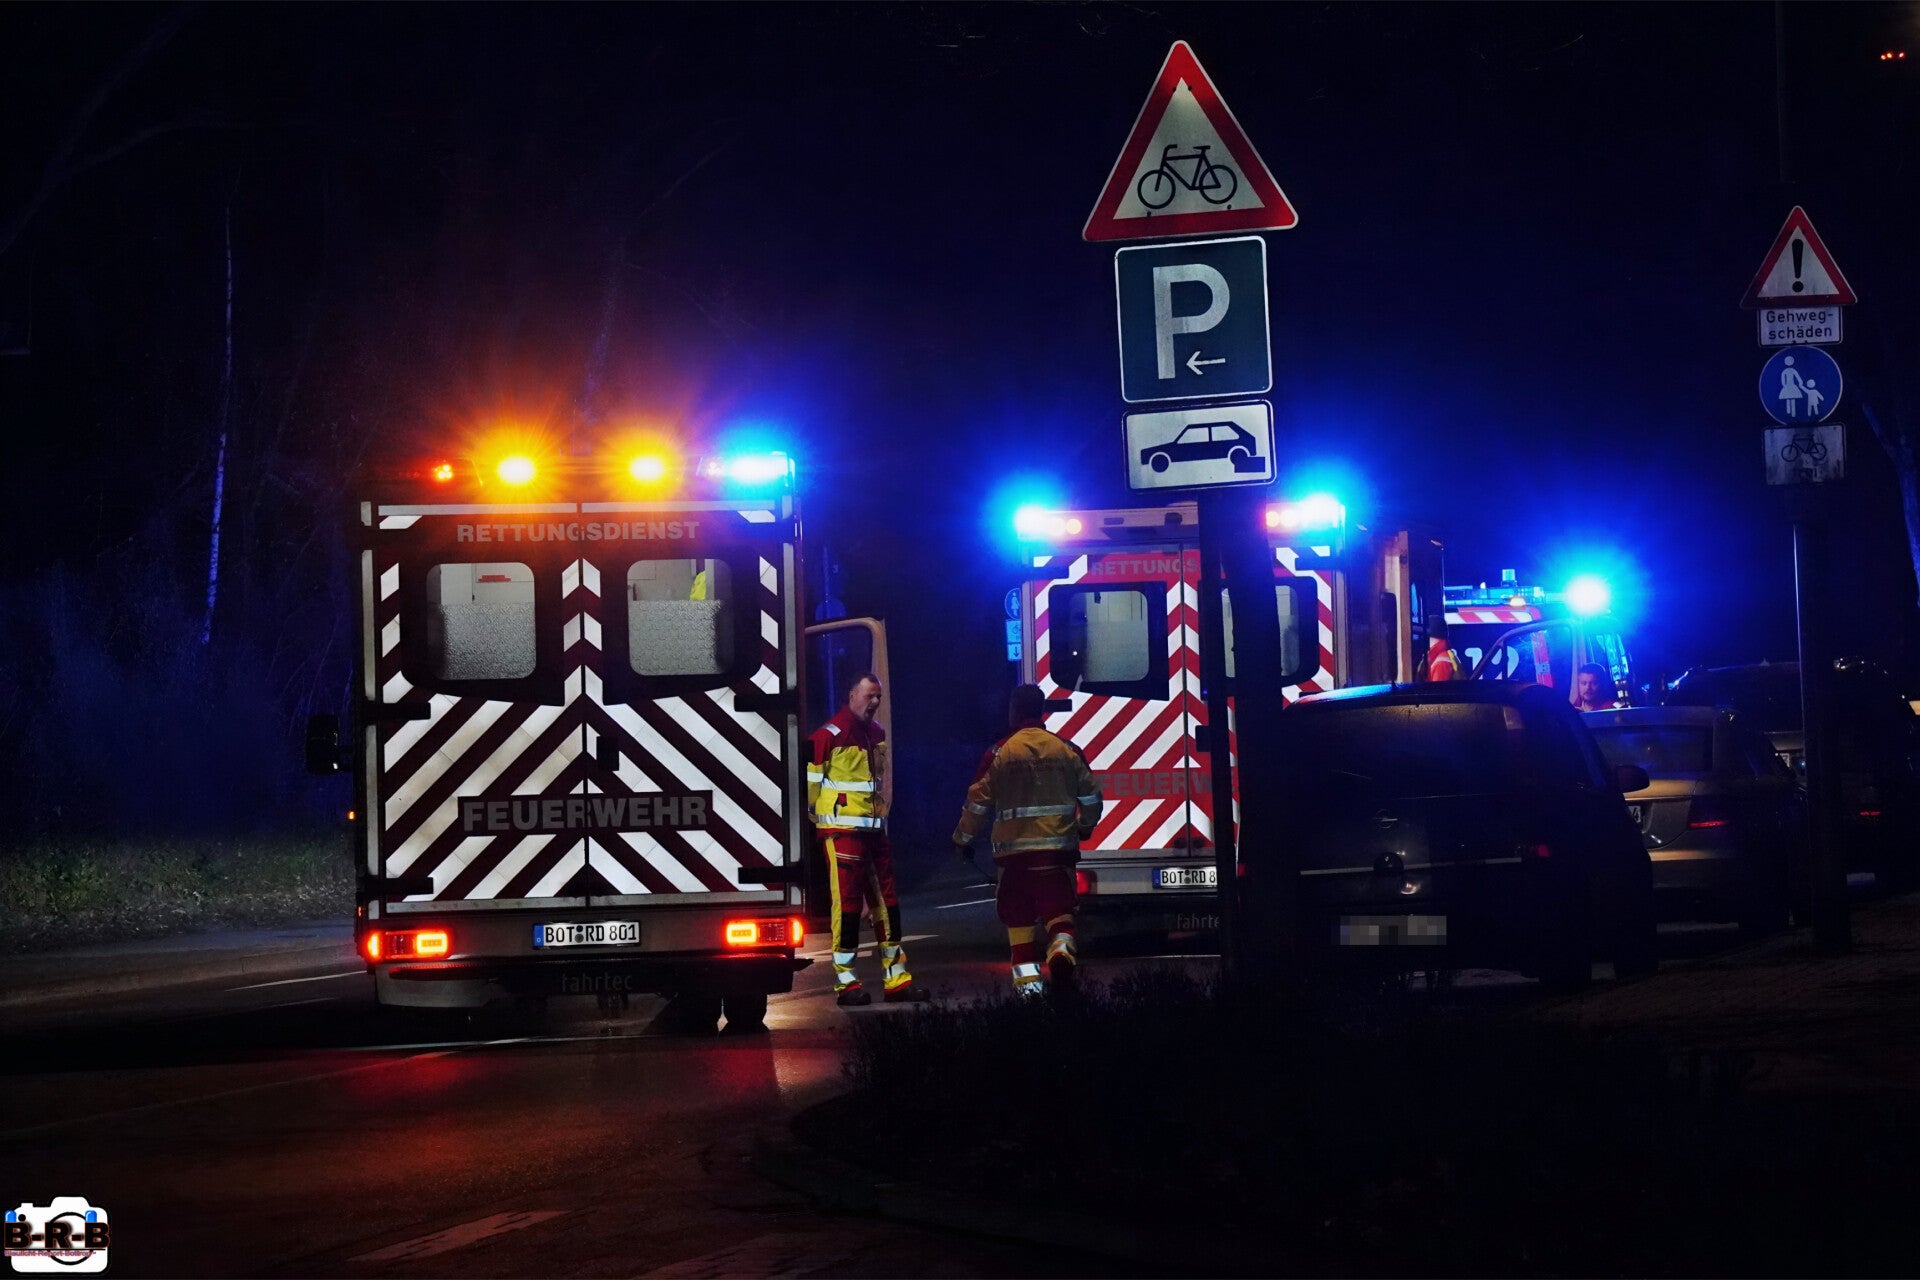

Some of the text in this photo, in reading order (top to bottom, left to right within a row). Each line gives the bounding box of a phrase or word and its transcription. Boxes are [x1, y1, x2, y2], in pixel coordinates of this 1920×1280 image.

[1152, 263, 1231, 380] P
[1766, 309, 1834, 324] Gehweg-
[1768, 325, 1832, 340] schäden
[456, 520, 700, 543] RETTUNGSDIENST
[1090, 556, 1199, 576] RETTUNGS
[1100, 771, 1213, 796] FEUERW
[462, 796, 708, 832] FEUERWEHR
[1161, 870, 1184, 885] BOT
[1191, 870, 1207, 884] RD
[1176, 912, 1221, 930] fahrte
[545, 926, 575, 943] BOT
[585, 924, 605, 942] RD
[609, 924, 637, 941] 801
